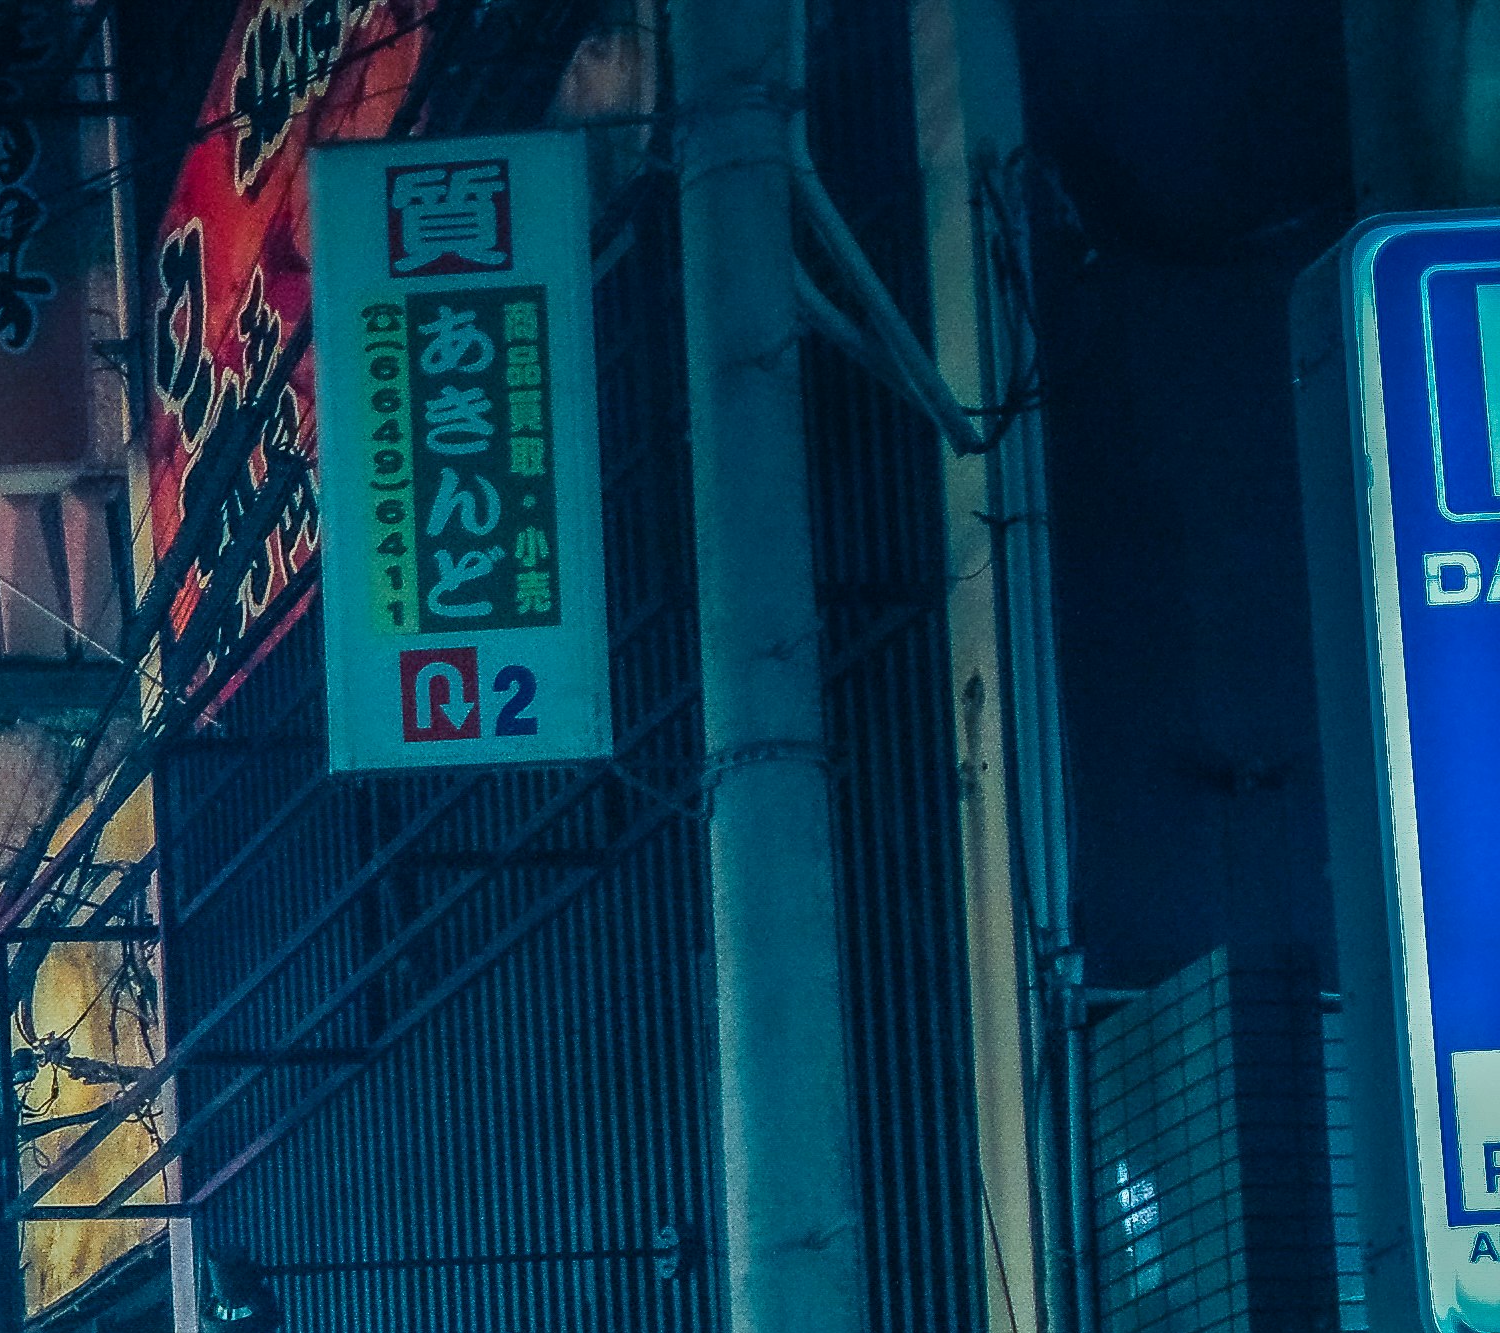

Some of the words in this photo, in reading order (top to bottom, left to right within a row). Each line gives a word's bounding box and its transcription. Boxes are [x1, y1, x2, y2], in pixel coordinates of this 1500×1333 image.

[392, 164, 508, 273] 質
[417, 304, 505, 619] あきんど
